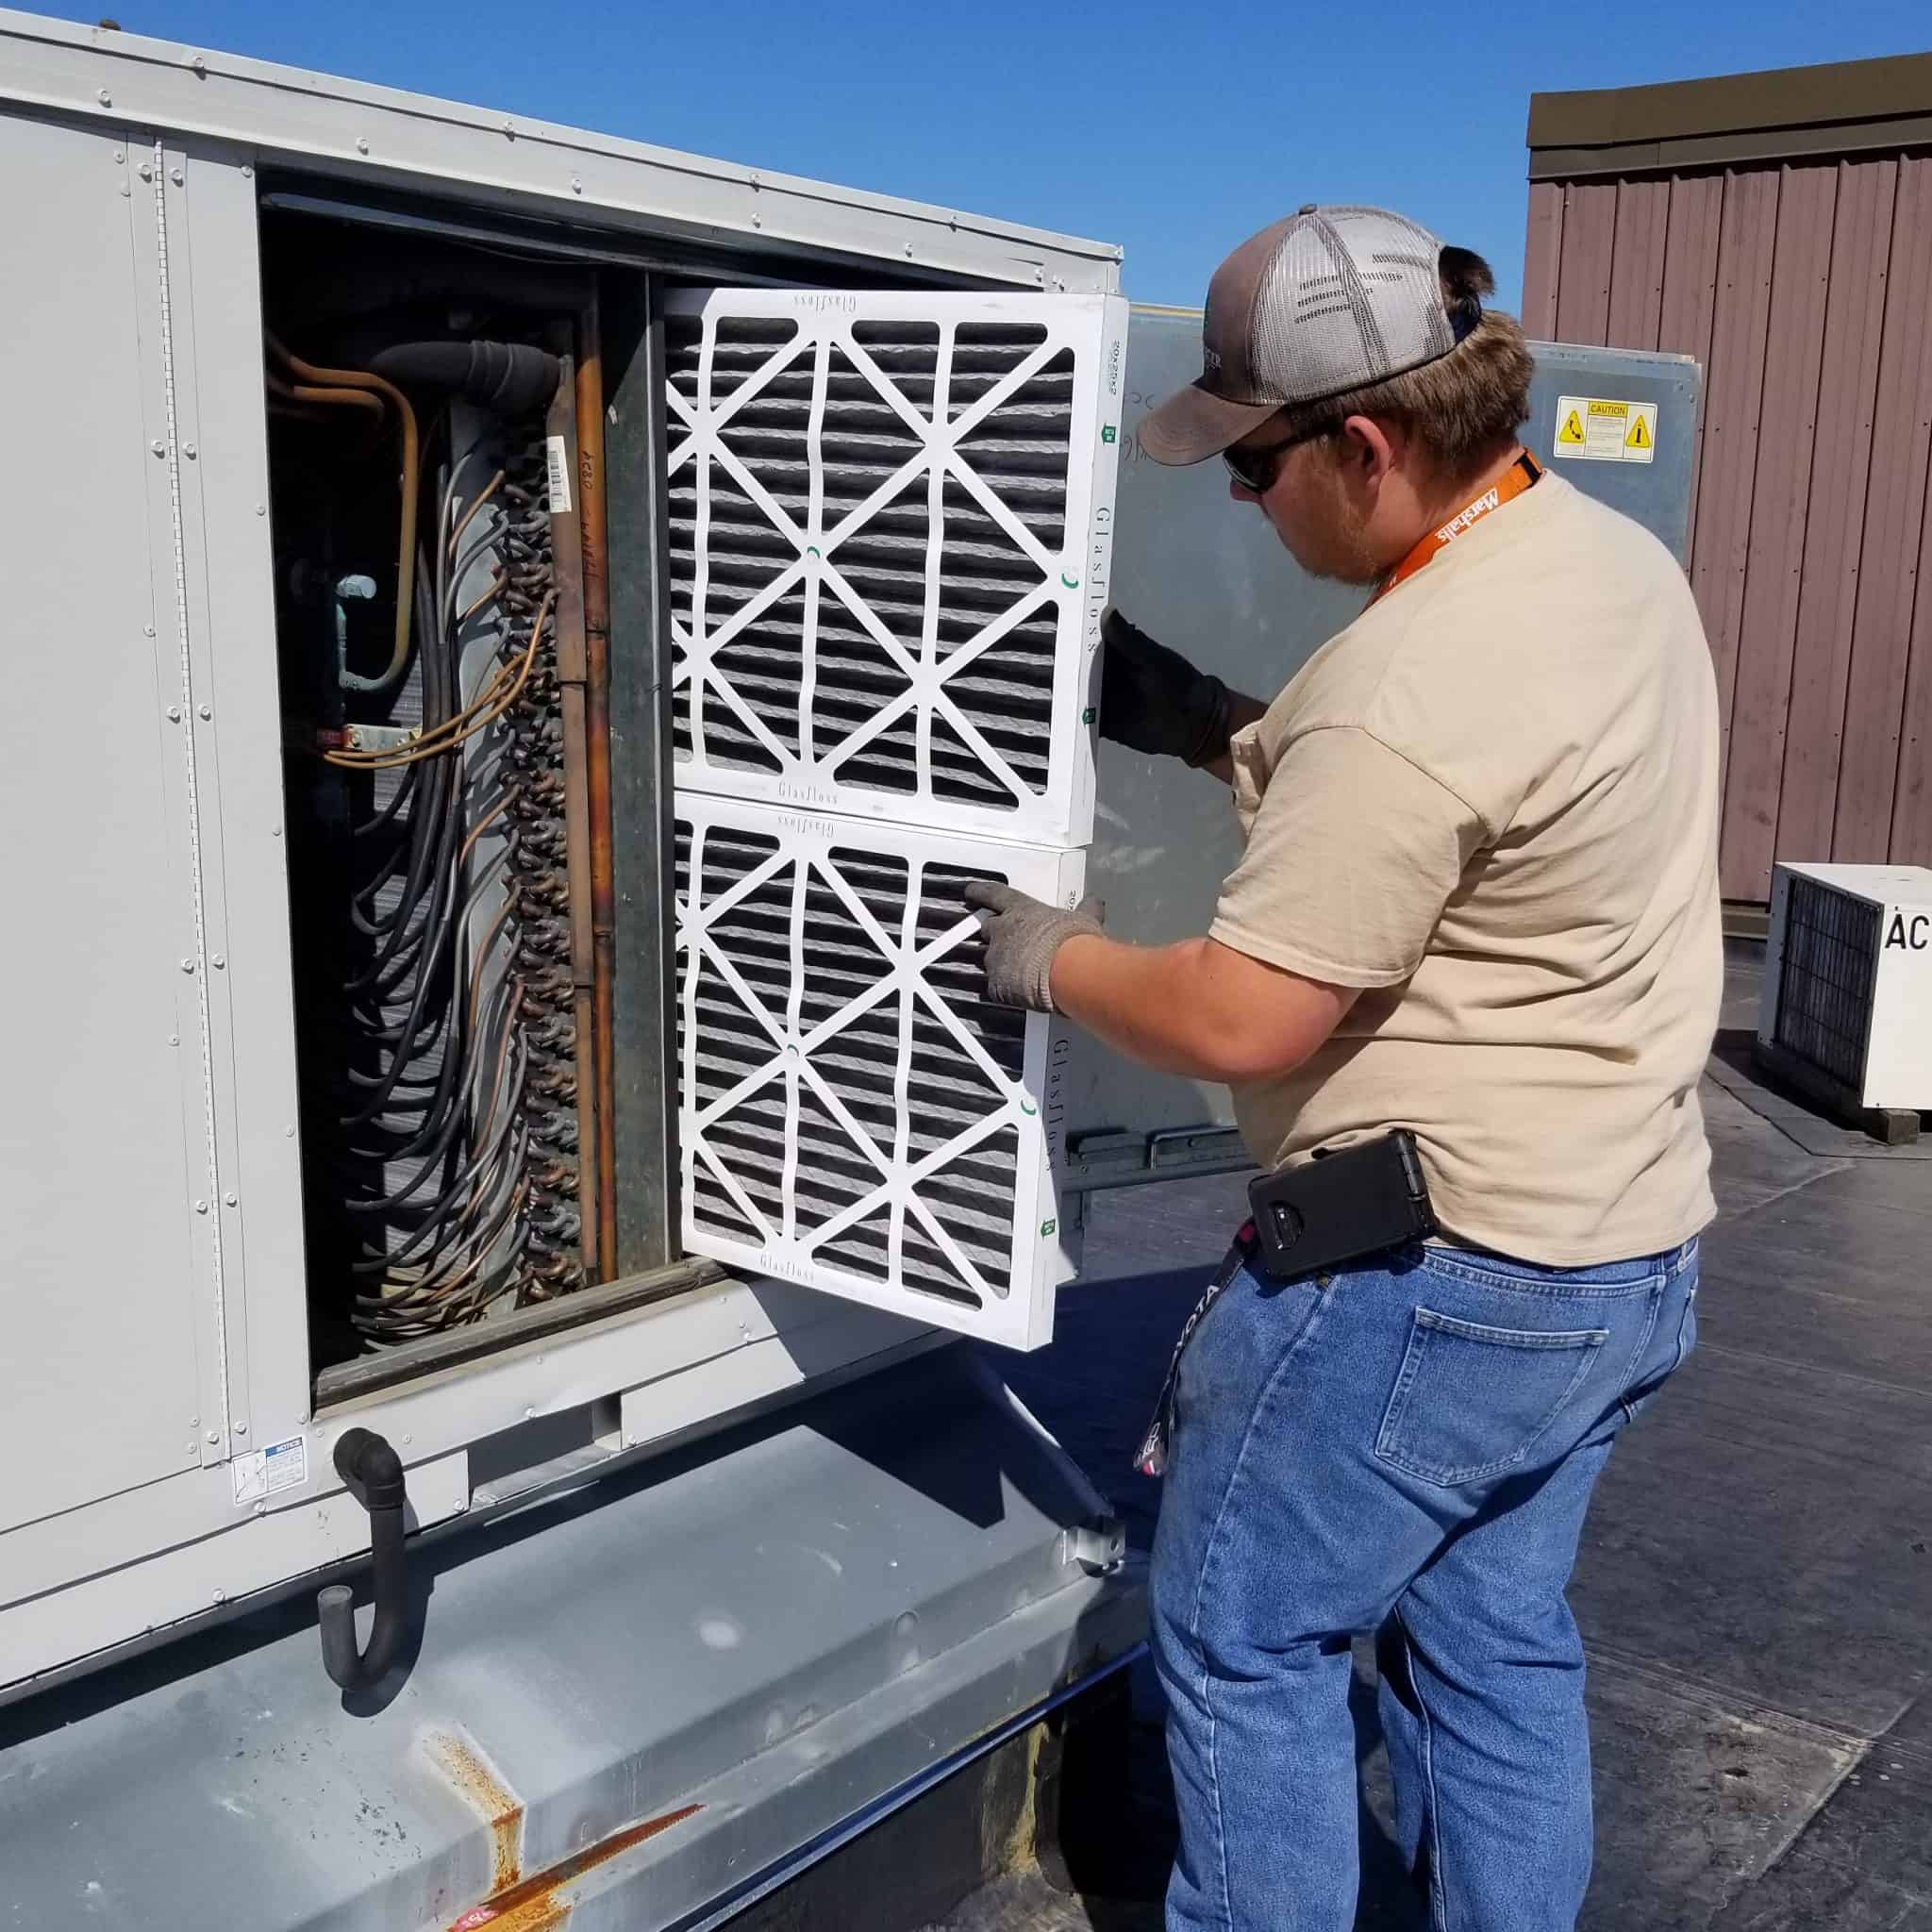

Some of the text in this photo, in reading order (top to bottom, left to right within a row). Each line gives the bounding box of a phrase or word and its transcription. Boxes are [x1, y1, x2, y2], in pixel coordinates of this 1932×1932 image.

[793, 294, 858, 312] Glasfloss
[1591, 404, 1625, 415] CAUTION
[1437, 486, 1498, 542] Marshalls
[1087, 507, 1111, 652] Glasfloss
[778, 781, 838, 805] Glasfloss
[777, 815, 837, 838] Glasfloss
[1885, 913, 1929, 950] AC
[1047, 1039, 1070, 1171] Glasfloss
[759, 1254, 815, 1281] Glasfloss
